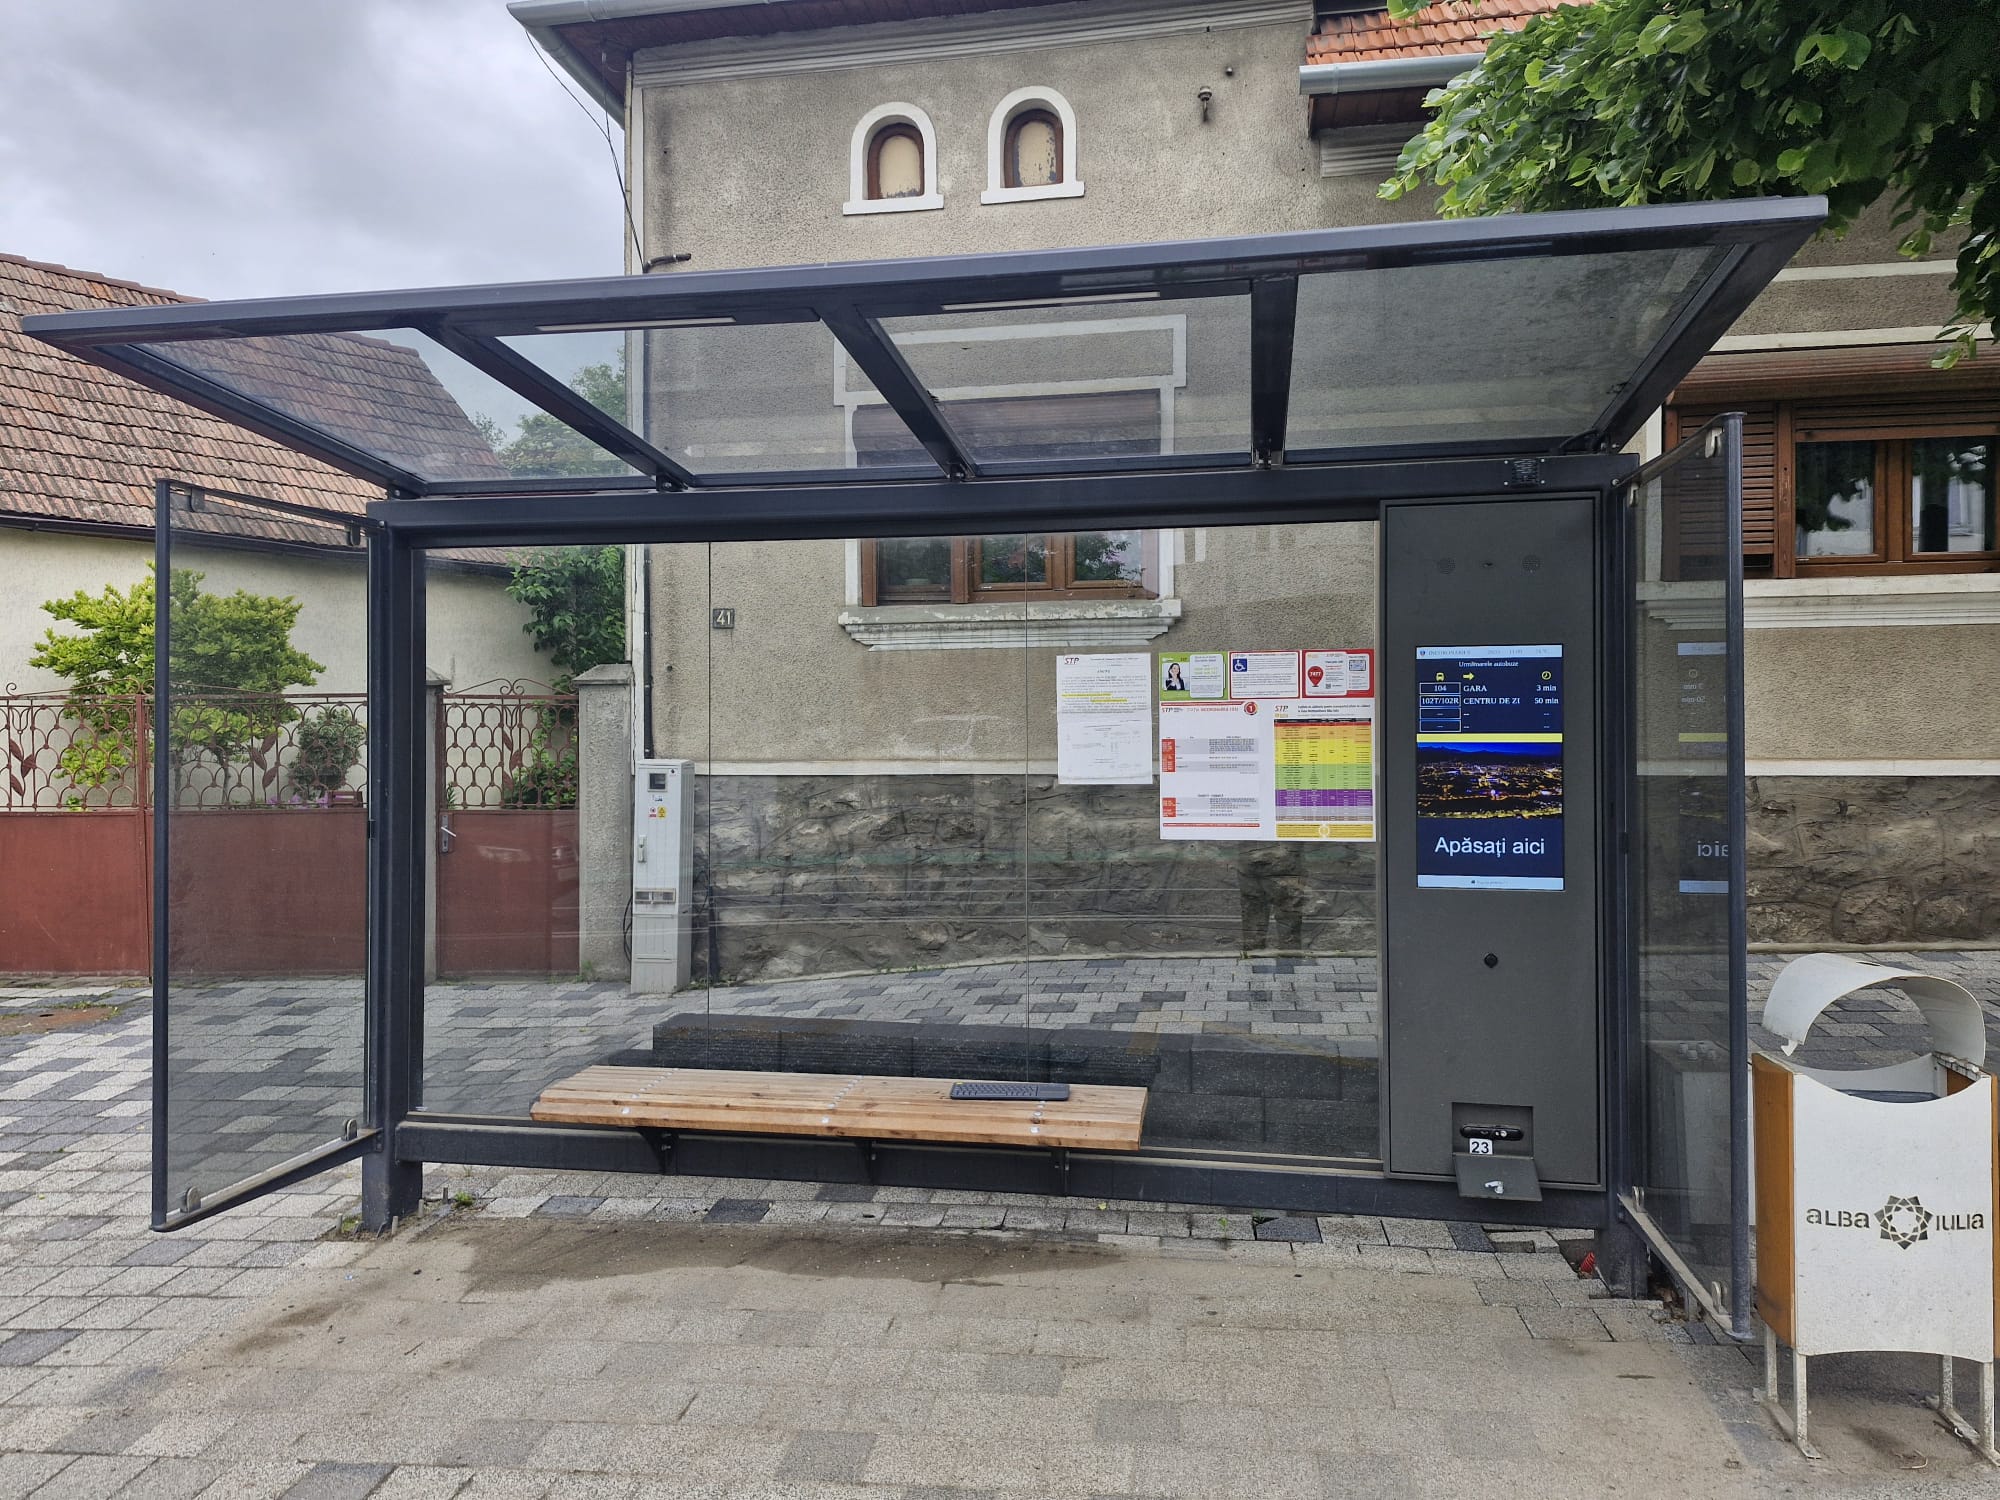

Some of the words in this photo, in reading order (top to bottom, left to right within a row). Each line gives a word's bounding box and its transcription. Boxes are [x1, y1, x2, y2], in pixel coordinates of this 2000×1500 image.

[716, 609, 731, 625] 41
[1064, 657, 1080, 665] STP
[1434, 684, 1447, 692] 104
[1463, 684, 1488, 692] GARA
[1536, 684, 1541, 692] 3
[1542, 684, 1557, 692] min
[1463, 697, 1497, 705] CENTRU
[1499, 697, 1510, 705] DE
[1544, 696, 1559, 704] min
[1512, 837, 1545, 855] aici
[1471, 1141, 1489, 1154] 23
